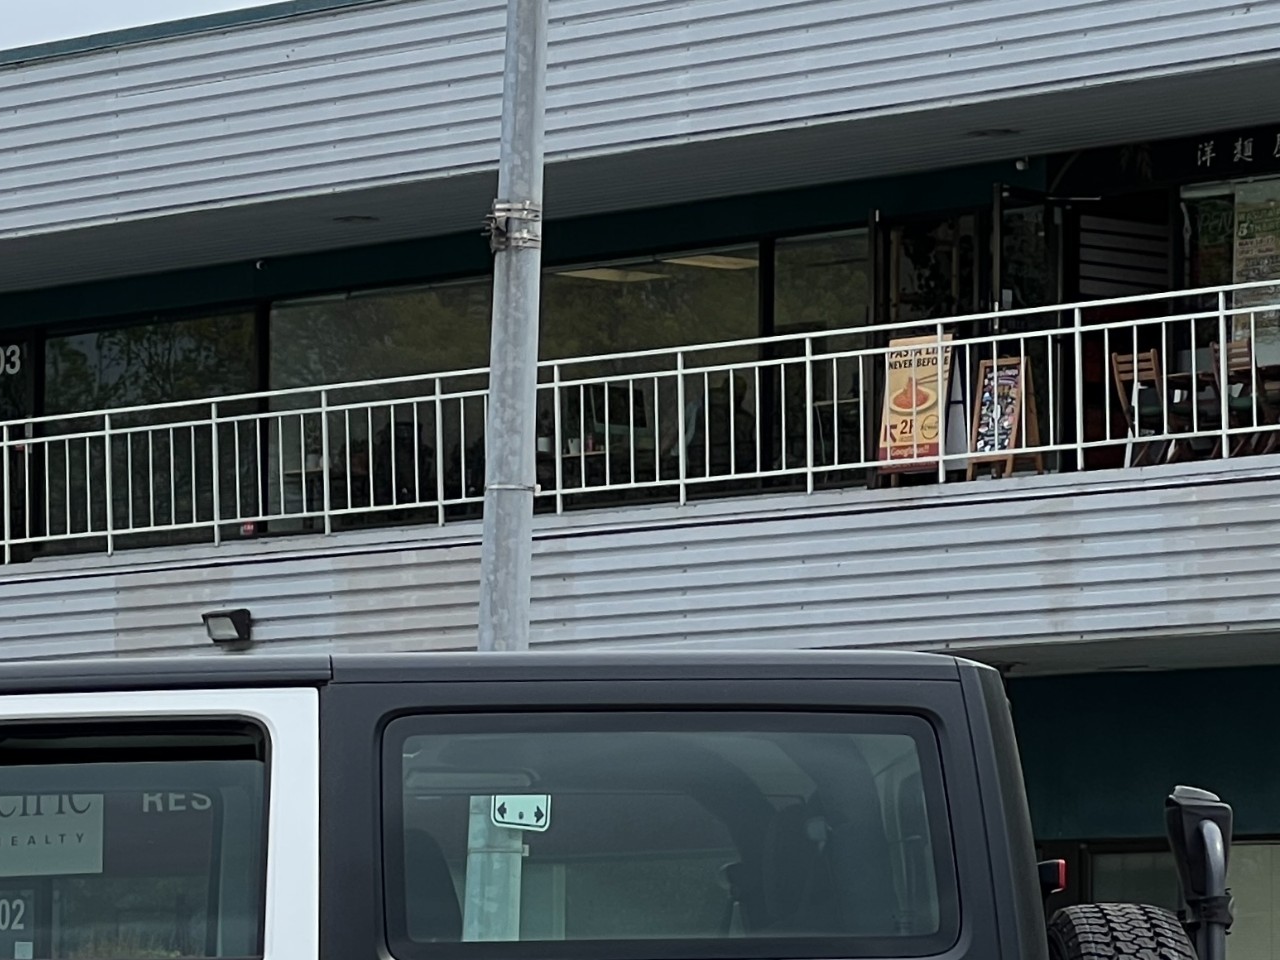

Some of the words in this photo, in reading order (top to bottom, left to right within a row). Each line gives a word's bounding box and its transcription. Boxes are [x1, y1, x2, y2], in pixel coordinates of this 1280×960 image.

[925, 345, 951, 355] LIE
[888, 358, 914, 370] NEVER
[917, 356, 950, 367] BEFOE
